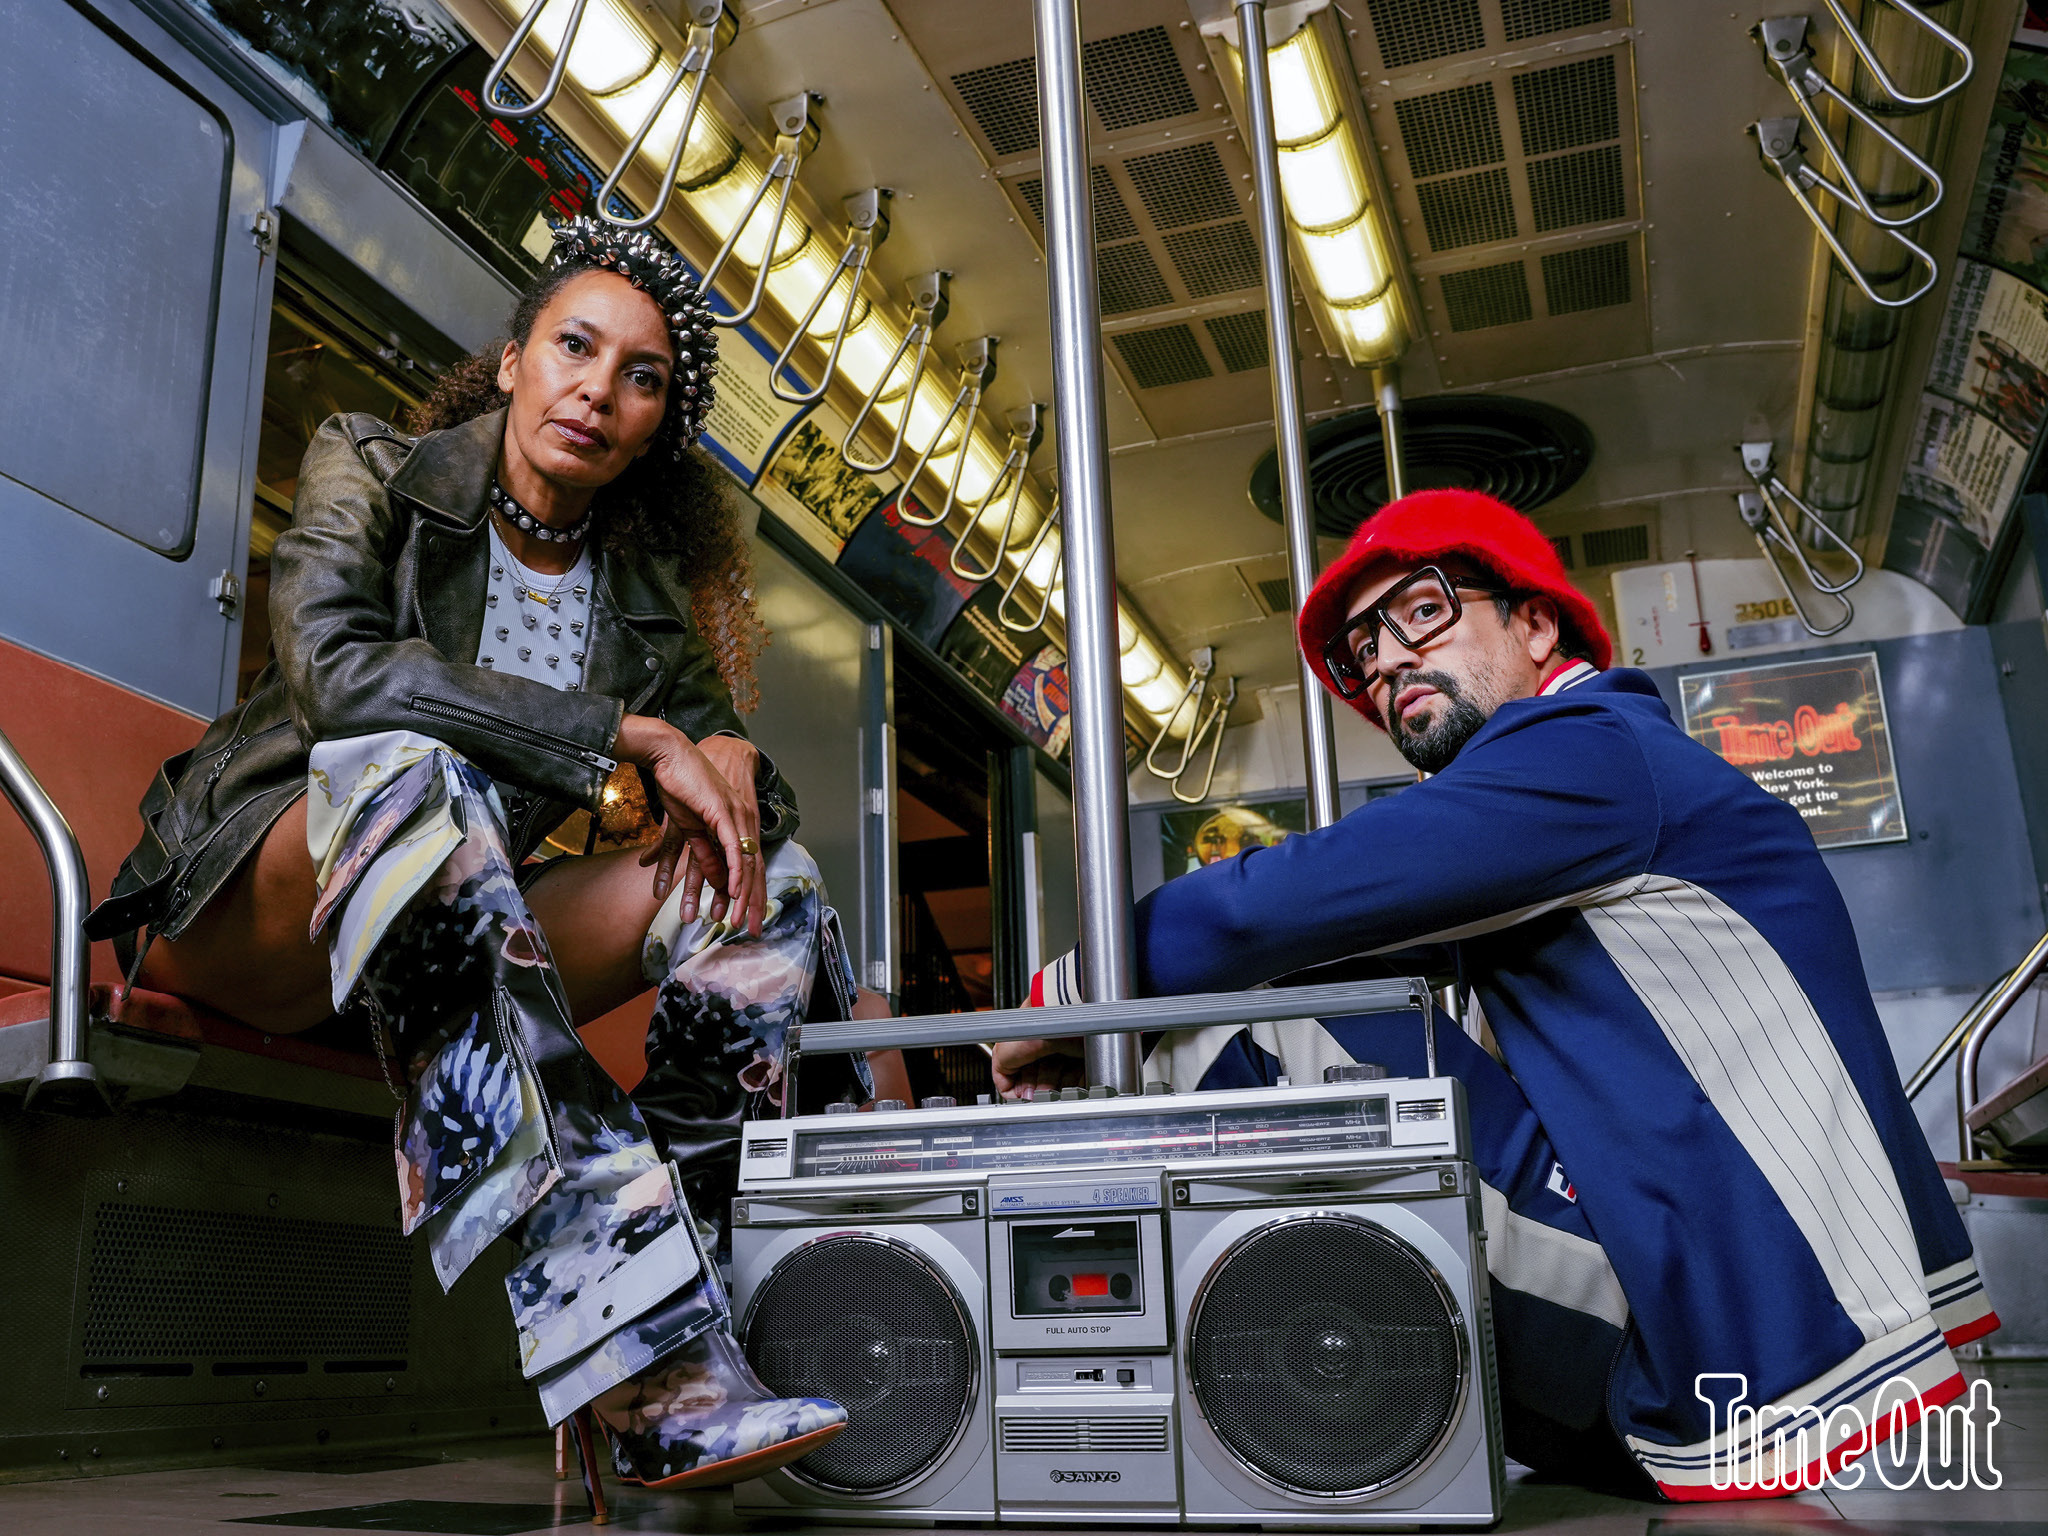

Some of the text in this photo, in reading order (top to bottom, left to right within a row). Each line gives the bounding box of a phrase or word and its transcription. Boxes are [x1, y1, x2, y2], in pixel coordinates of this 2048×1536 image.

[1633, 648, 1646, 666] 2
[1711, 702, 1862, 766] Time Out
[1751, 763, 1834, 782] Welcome to
[1761, 778, 1830, 794] New York.
[1789, 791, 1839, 807] get the
[1800, 806, 1828, 818] out.
[1093, 1187, 1150, 1204] 4 SPEAKER
[1045, 1325, 1111, 1334] FULL AUTO STOP
[1063, 1471, 1120, 1482] SANYO
